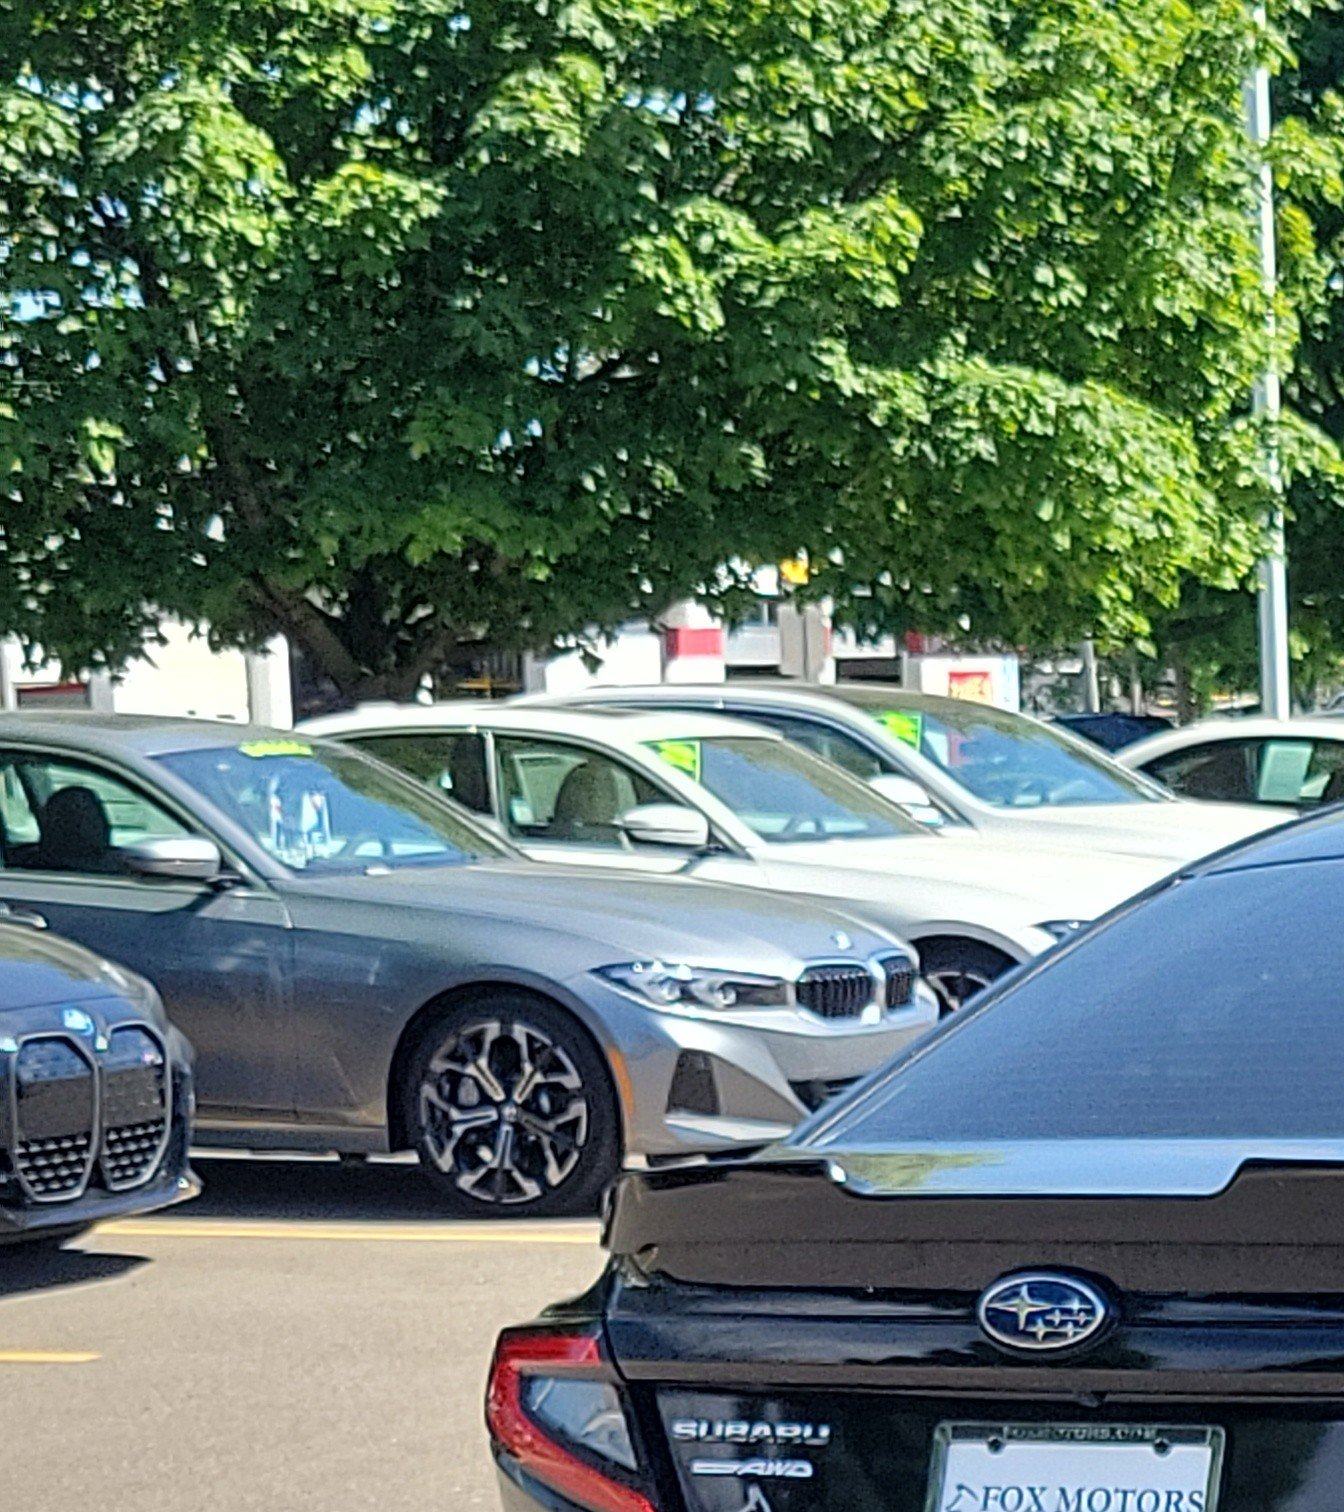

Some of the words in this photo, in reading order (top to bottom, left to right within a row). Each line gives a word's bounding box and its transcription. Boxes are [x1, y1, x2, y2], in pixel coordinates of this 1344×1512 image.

[672, 1420, 831, 1446] SUBARU
[737, 1459, 814, 1478] AWD
[980, 1486, 1047, 1512] FOX
